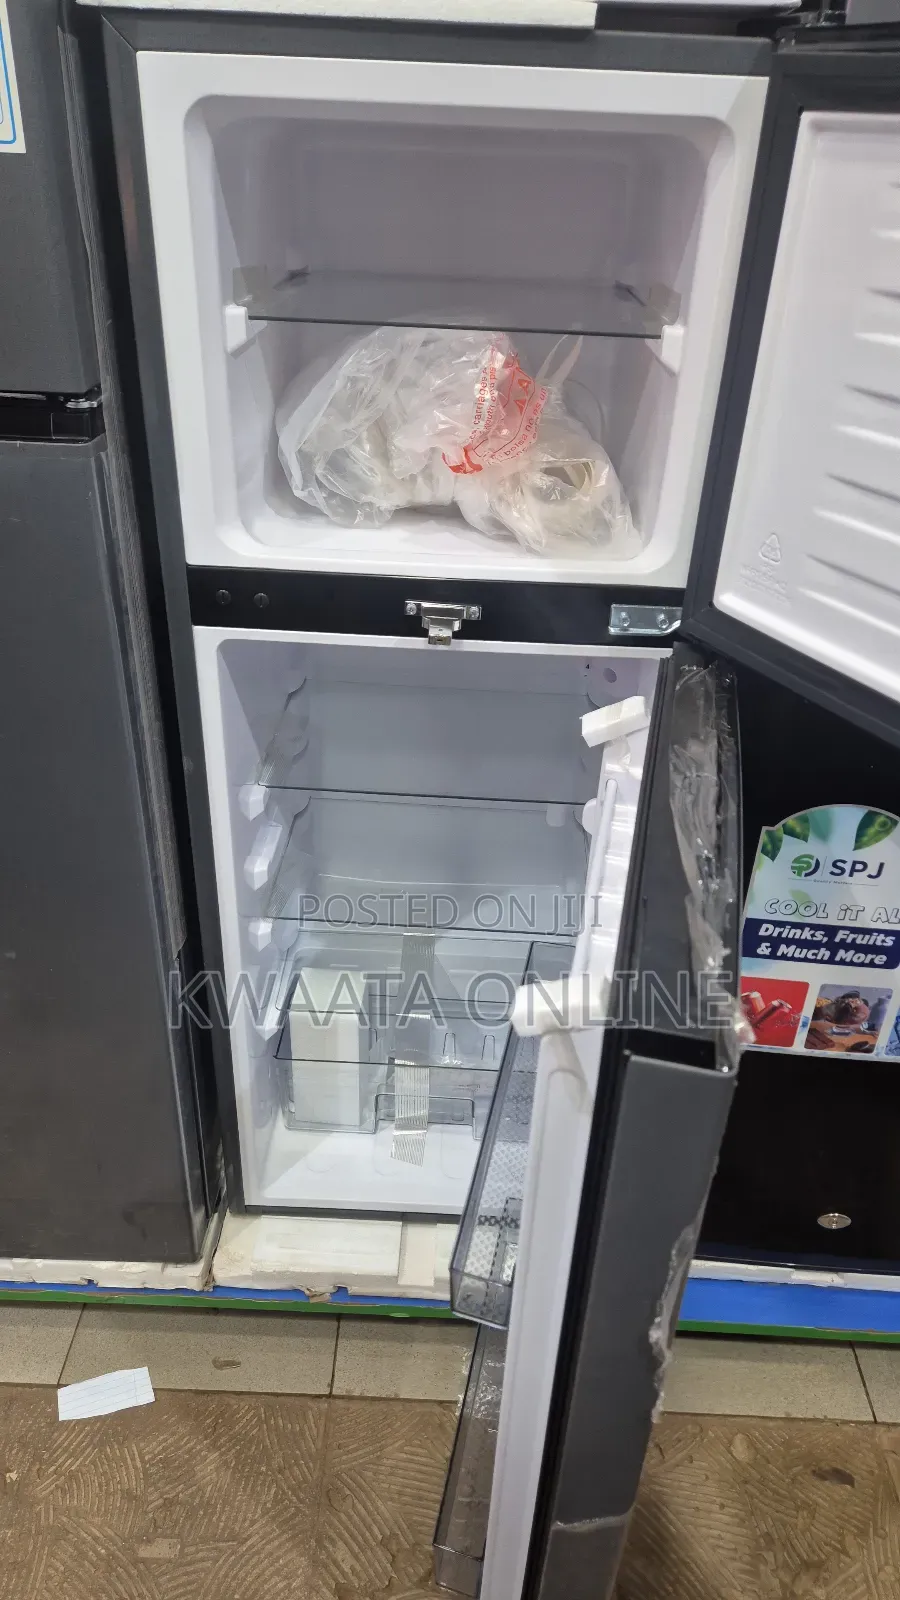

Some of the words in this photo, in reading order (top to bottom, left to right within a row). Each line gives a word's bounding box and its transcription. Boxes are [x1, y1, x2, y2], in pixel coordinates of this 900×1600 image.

[505, 433, 528, 457] bolsa
[829, 858, 886, 880] SPJ
[764, 898, 829, 919] COOL
[758, 923, 829, 944] Drinks,
[834, 930, 896, 947] Fruits
[756, 942, 772, 956] &
[777, 944, 831, 962] Much
[834, 948, 888, 966] More
